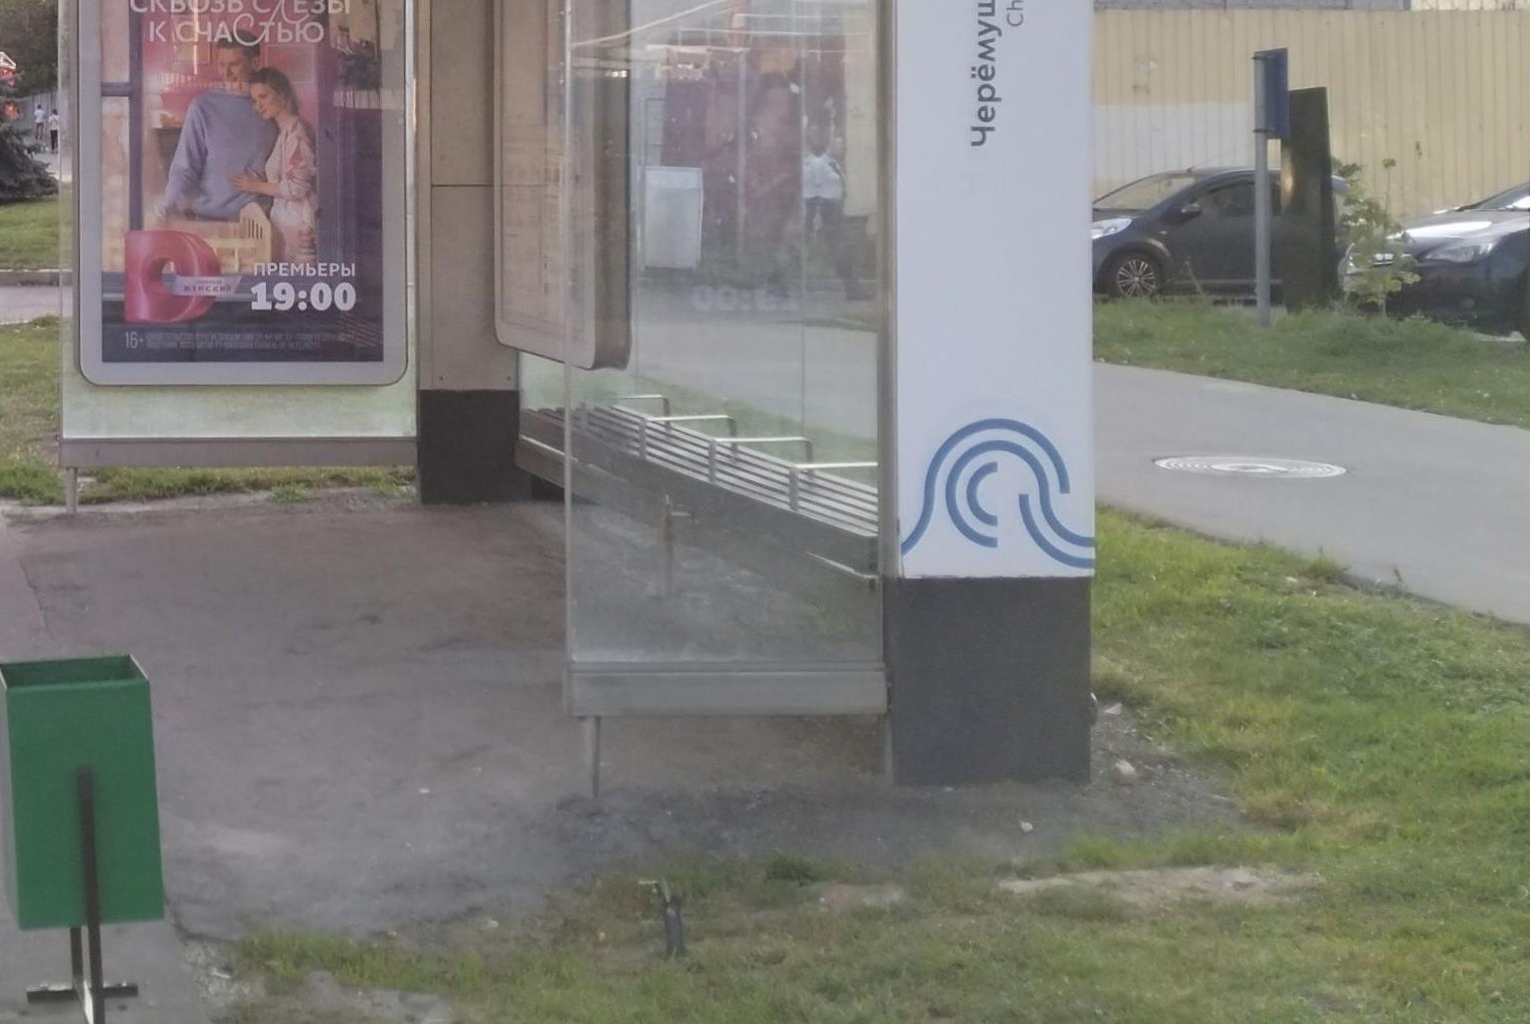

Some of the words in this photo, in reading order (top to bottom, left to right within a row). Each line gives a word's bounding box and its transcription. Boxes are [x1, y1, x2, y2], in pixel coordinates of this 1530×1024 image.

[150, 21, 167, 43] К
[176, 13, 325, 46] СЧАСТЬЮ
[254, 263, 356, 277] ПРЕМЬЕРЫ
[251, 282, 357, 311] 19:00
[125, 331, 144, 349] 16+
